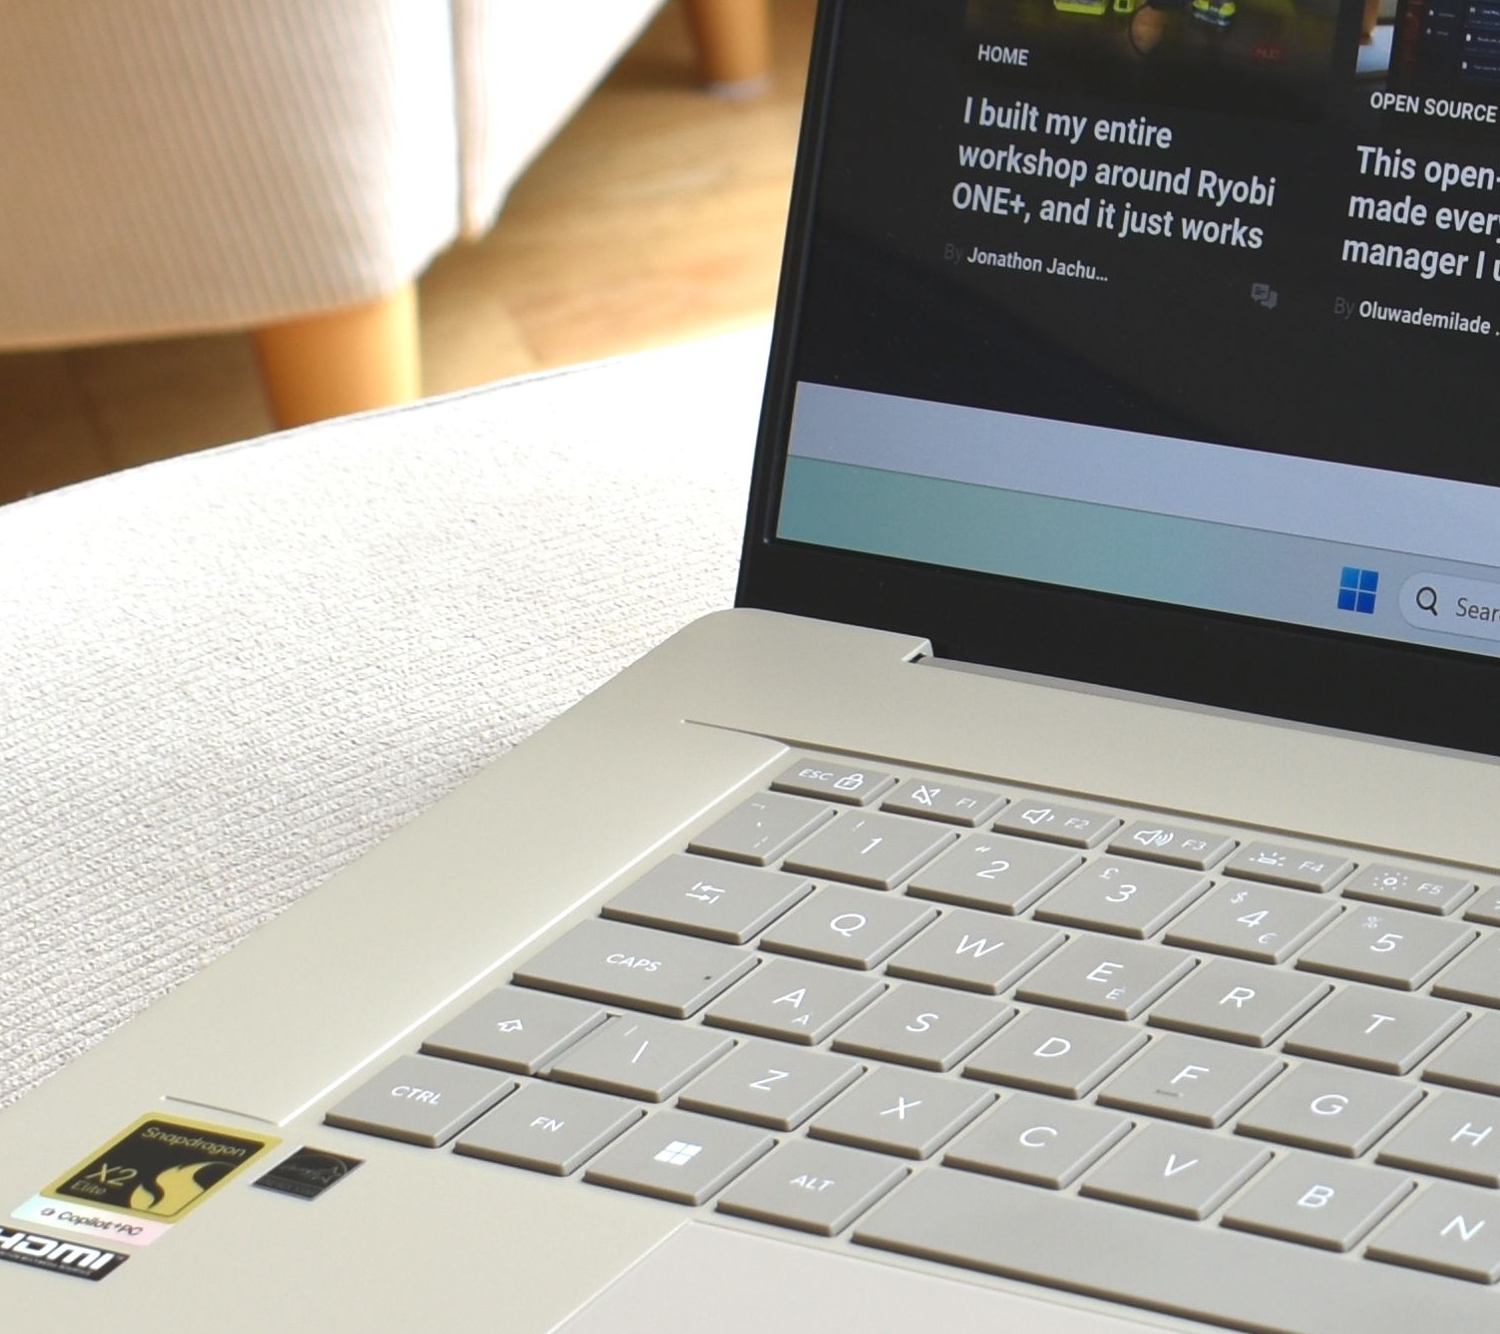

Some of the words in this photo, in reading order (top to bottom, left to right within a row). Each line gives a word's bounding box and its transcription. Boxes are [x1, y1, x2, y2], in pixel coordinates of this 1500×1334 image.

[977, 44, 1030, 67] HOME
[963, 96, 973, 124] I
[978, 97, 1040, 133] built
[1045, 112, 1088, 145] my
[1093, 116, 1173, 149] entire
[958, 144, 1088, 188] workshop
[1094, 163, 1191, 196] around
[1197, 169, 1276, 208] Ryobi
[952, 181, 1031, 224] ONE+,
[1039, 197, 1091, 226] and
[1096, 198, 1116, 230] it
[1117, 202, 1174, 238] just
[1181, 217, 1264, 249] works
[966, 246, 1043, 273] Jonathon
[798, 768, 833, 781] ESC
[829, 913, 866, 938] Q
[606, 953, 662, 972] CAPS
[391, 1085, 441, 1105] CTRL
[529, 1116, 565, 1132] FN
[141, 1126, 248, 1158] Snapdragon
[70, 1179, 108, 1196] Elite
[85, 1163, 139, 1188] X2
[789, 1174, 835, 1191] ALT
